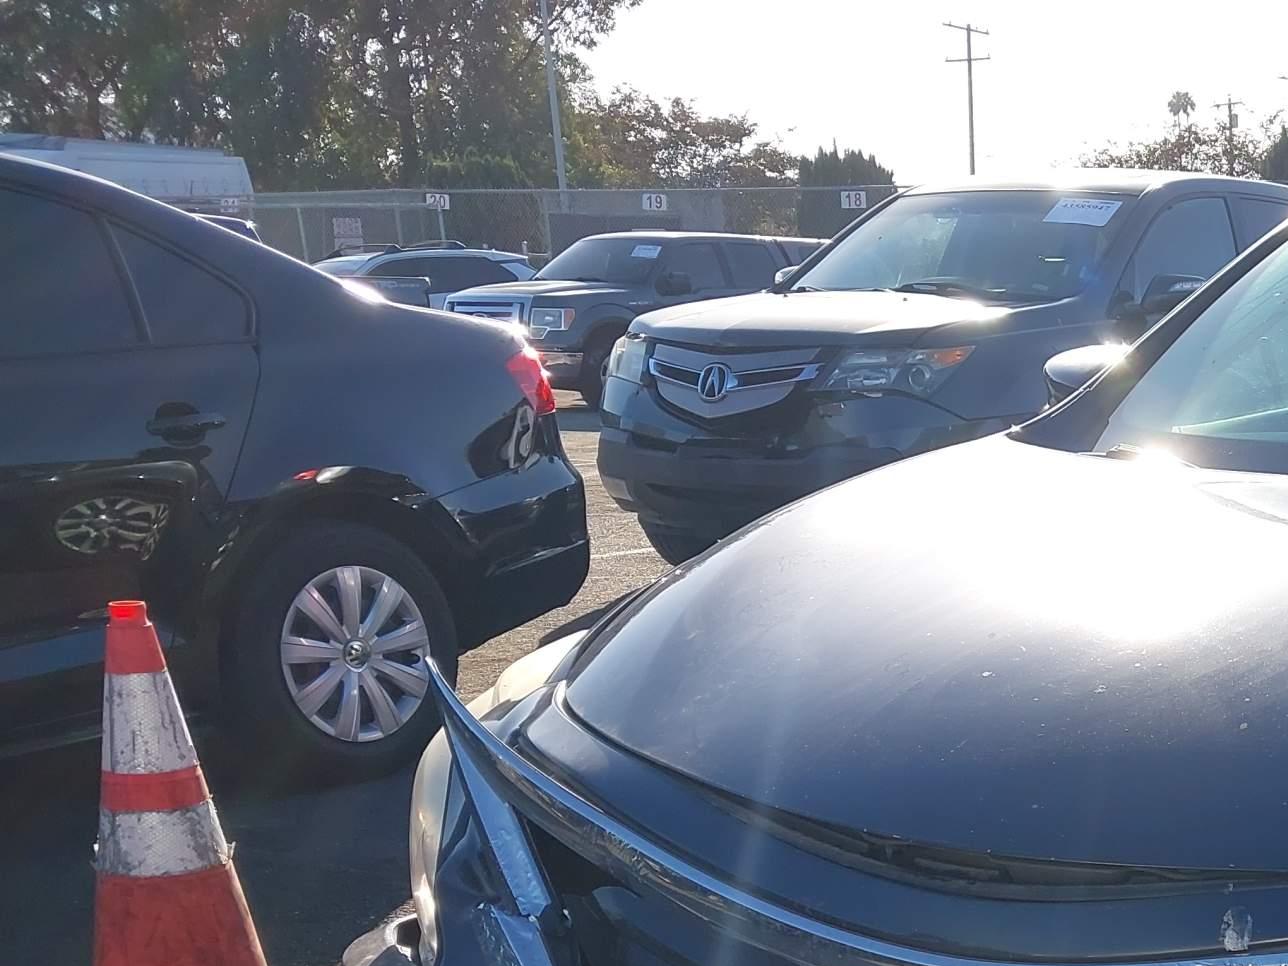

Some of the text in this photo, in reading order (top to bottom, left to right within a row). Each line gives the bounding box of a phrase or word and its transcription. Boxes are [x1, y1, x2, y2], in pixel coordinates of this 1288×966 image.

[430, 194, 446, 208] 20
[646, 195, 662, 209] 19
[845, 192, 861, 207] 18
